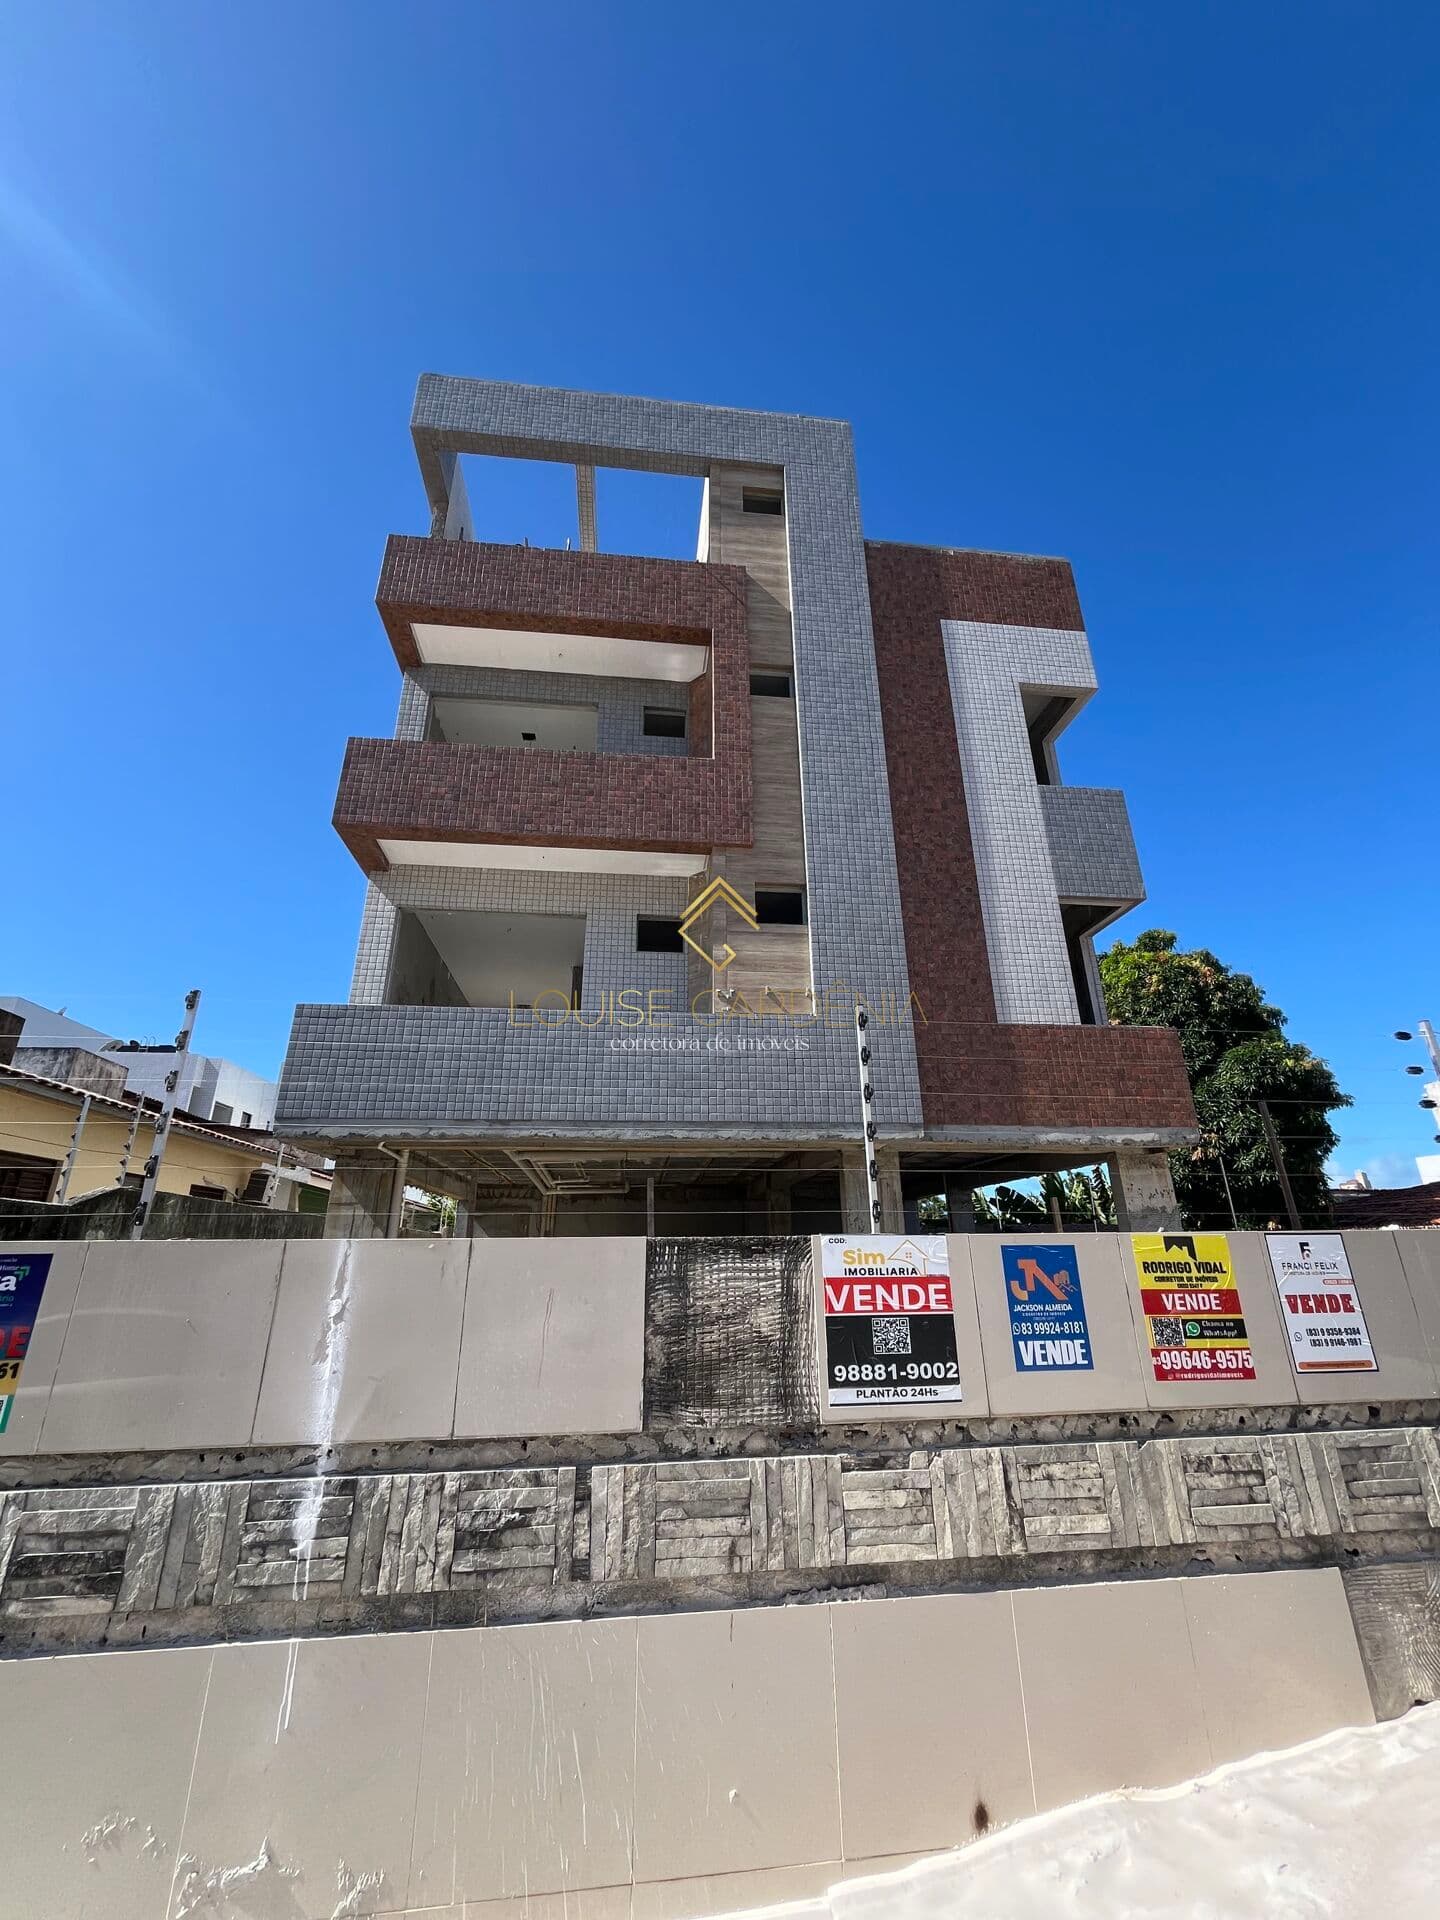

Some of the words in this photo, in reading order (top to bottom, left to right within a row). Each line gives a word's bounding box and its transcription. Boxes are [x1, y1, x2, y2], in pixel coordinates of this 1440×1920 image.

[842, 1248, 885, 1265] Sim
[844, 1267, 918, 1276] IMOBILIARIA
[1142, 1261, 1192, 1274] RODRIGO
[1194, 1261, 1227, 1274] VIDAL
[1281, 1262, 1313, 1270] FRANCI
[1314, 1262, 1338, 1270] FELIX
[825, 1283, 948, 1312] VENDE
[1160, 1293, 1222, 1311] VENDE
[1284, 1293, 1355, 1314] VENDE
[1013, 1303, 1044, 1312] JACKSON
[1045, 1303, 1073, 1312] ALMEIDA
[1021, 1322, 1032, 1335] 83
[1034, 1321, 1084, 1334] 99924-8181
[1018, 1339, 1088, 1366] VENDE
[1160, 1350, 1255, 1370] 99646-9575
[834, 1362, 959, 1382] 98881-9002
[856, 1386, 908, 1399] PLANTÃO
[910, 1387, 939, 1398] 24Hs
